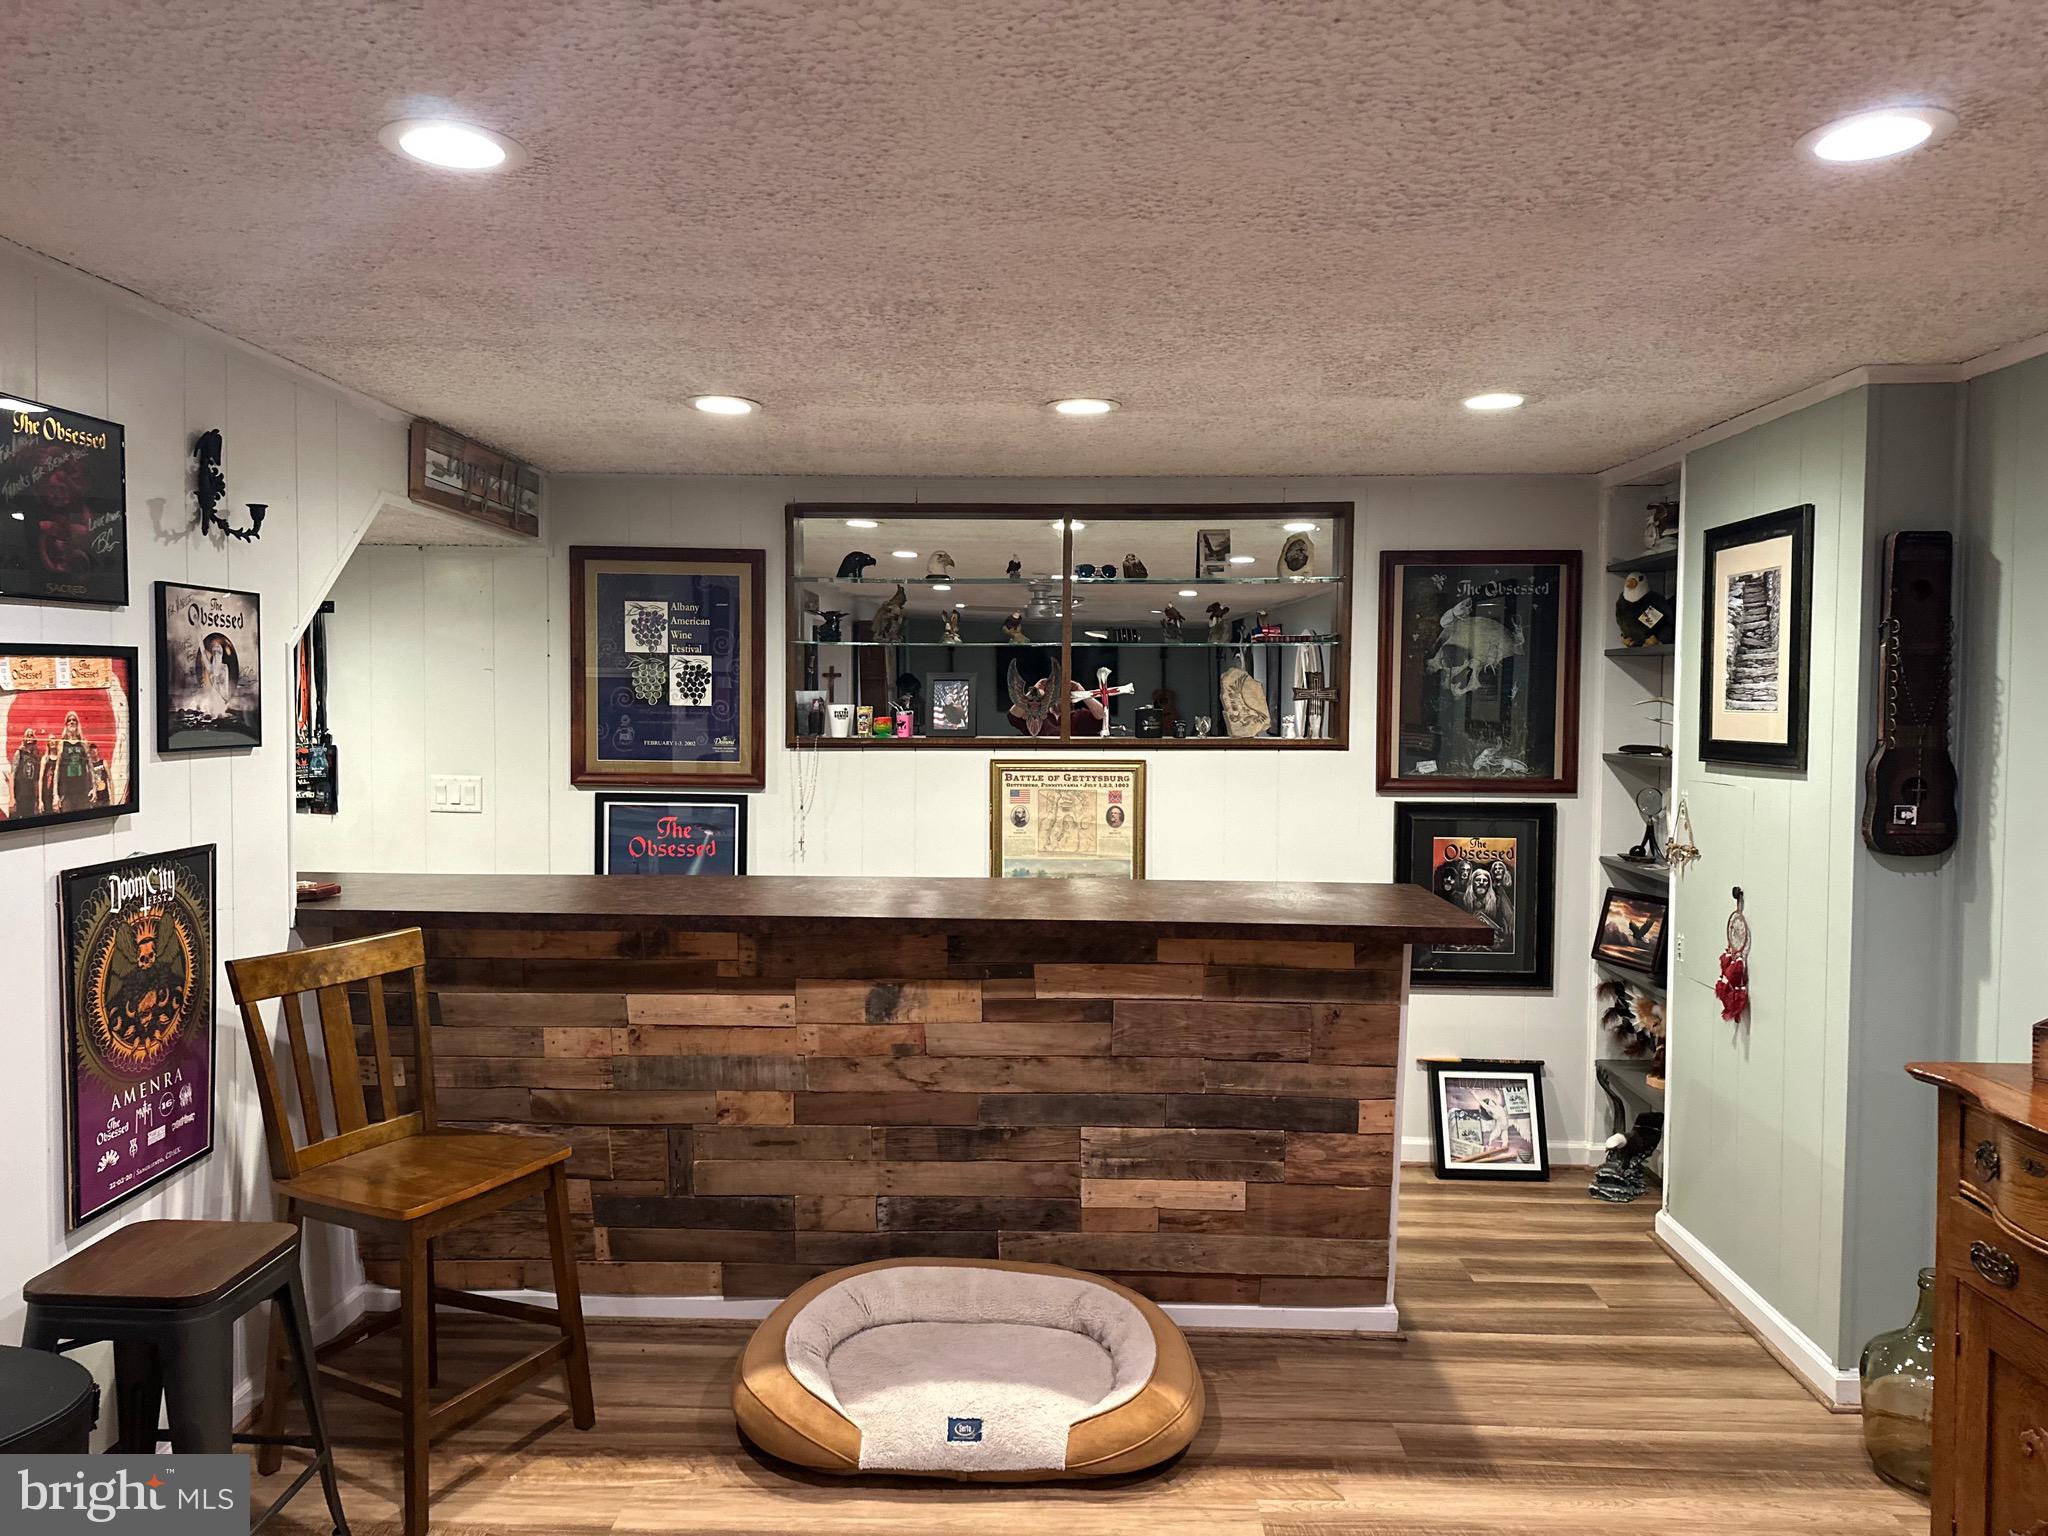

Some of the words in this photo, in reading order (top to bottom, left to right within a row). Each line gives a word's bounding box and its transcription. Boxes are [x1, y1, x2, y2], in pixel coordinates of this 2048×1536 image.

[13, 410, 40, 434] The
[43, 417, 106, 449] Obsessed
[1456, 579, 1481, 597] The
[1485, 580, 1549, 597] Obsessed
[210, 598, 223, 611] The
[671, 602, 700, 614] Albany
[188, 603, 244, 629] Obsessed
[671, 616, 711, 626] American
[671, 630, 692, 639] Wine
[671, 644, 702, 653] Festival
[1005, 773, 1044, 781] BATTLE
[1063, 773, 1130, 782] GETTYSBURG
[656, 816, 692, 839] The
[628, 835, 717, 858] Obsessed
[1470, 838, 1487, 848] The
[1444, 844, 1515, 861] Obsessed
[148, 893, 168, 905] FEST
[111, 1067, 183, 1112] AMENRA
[161, 1099, 173, 1110] 16
[107, 1117, 121, 1130] The
[96, 1122, 129, 1146] Obsessed
[958, 1424, 972, 1433] Serta
